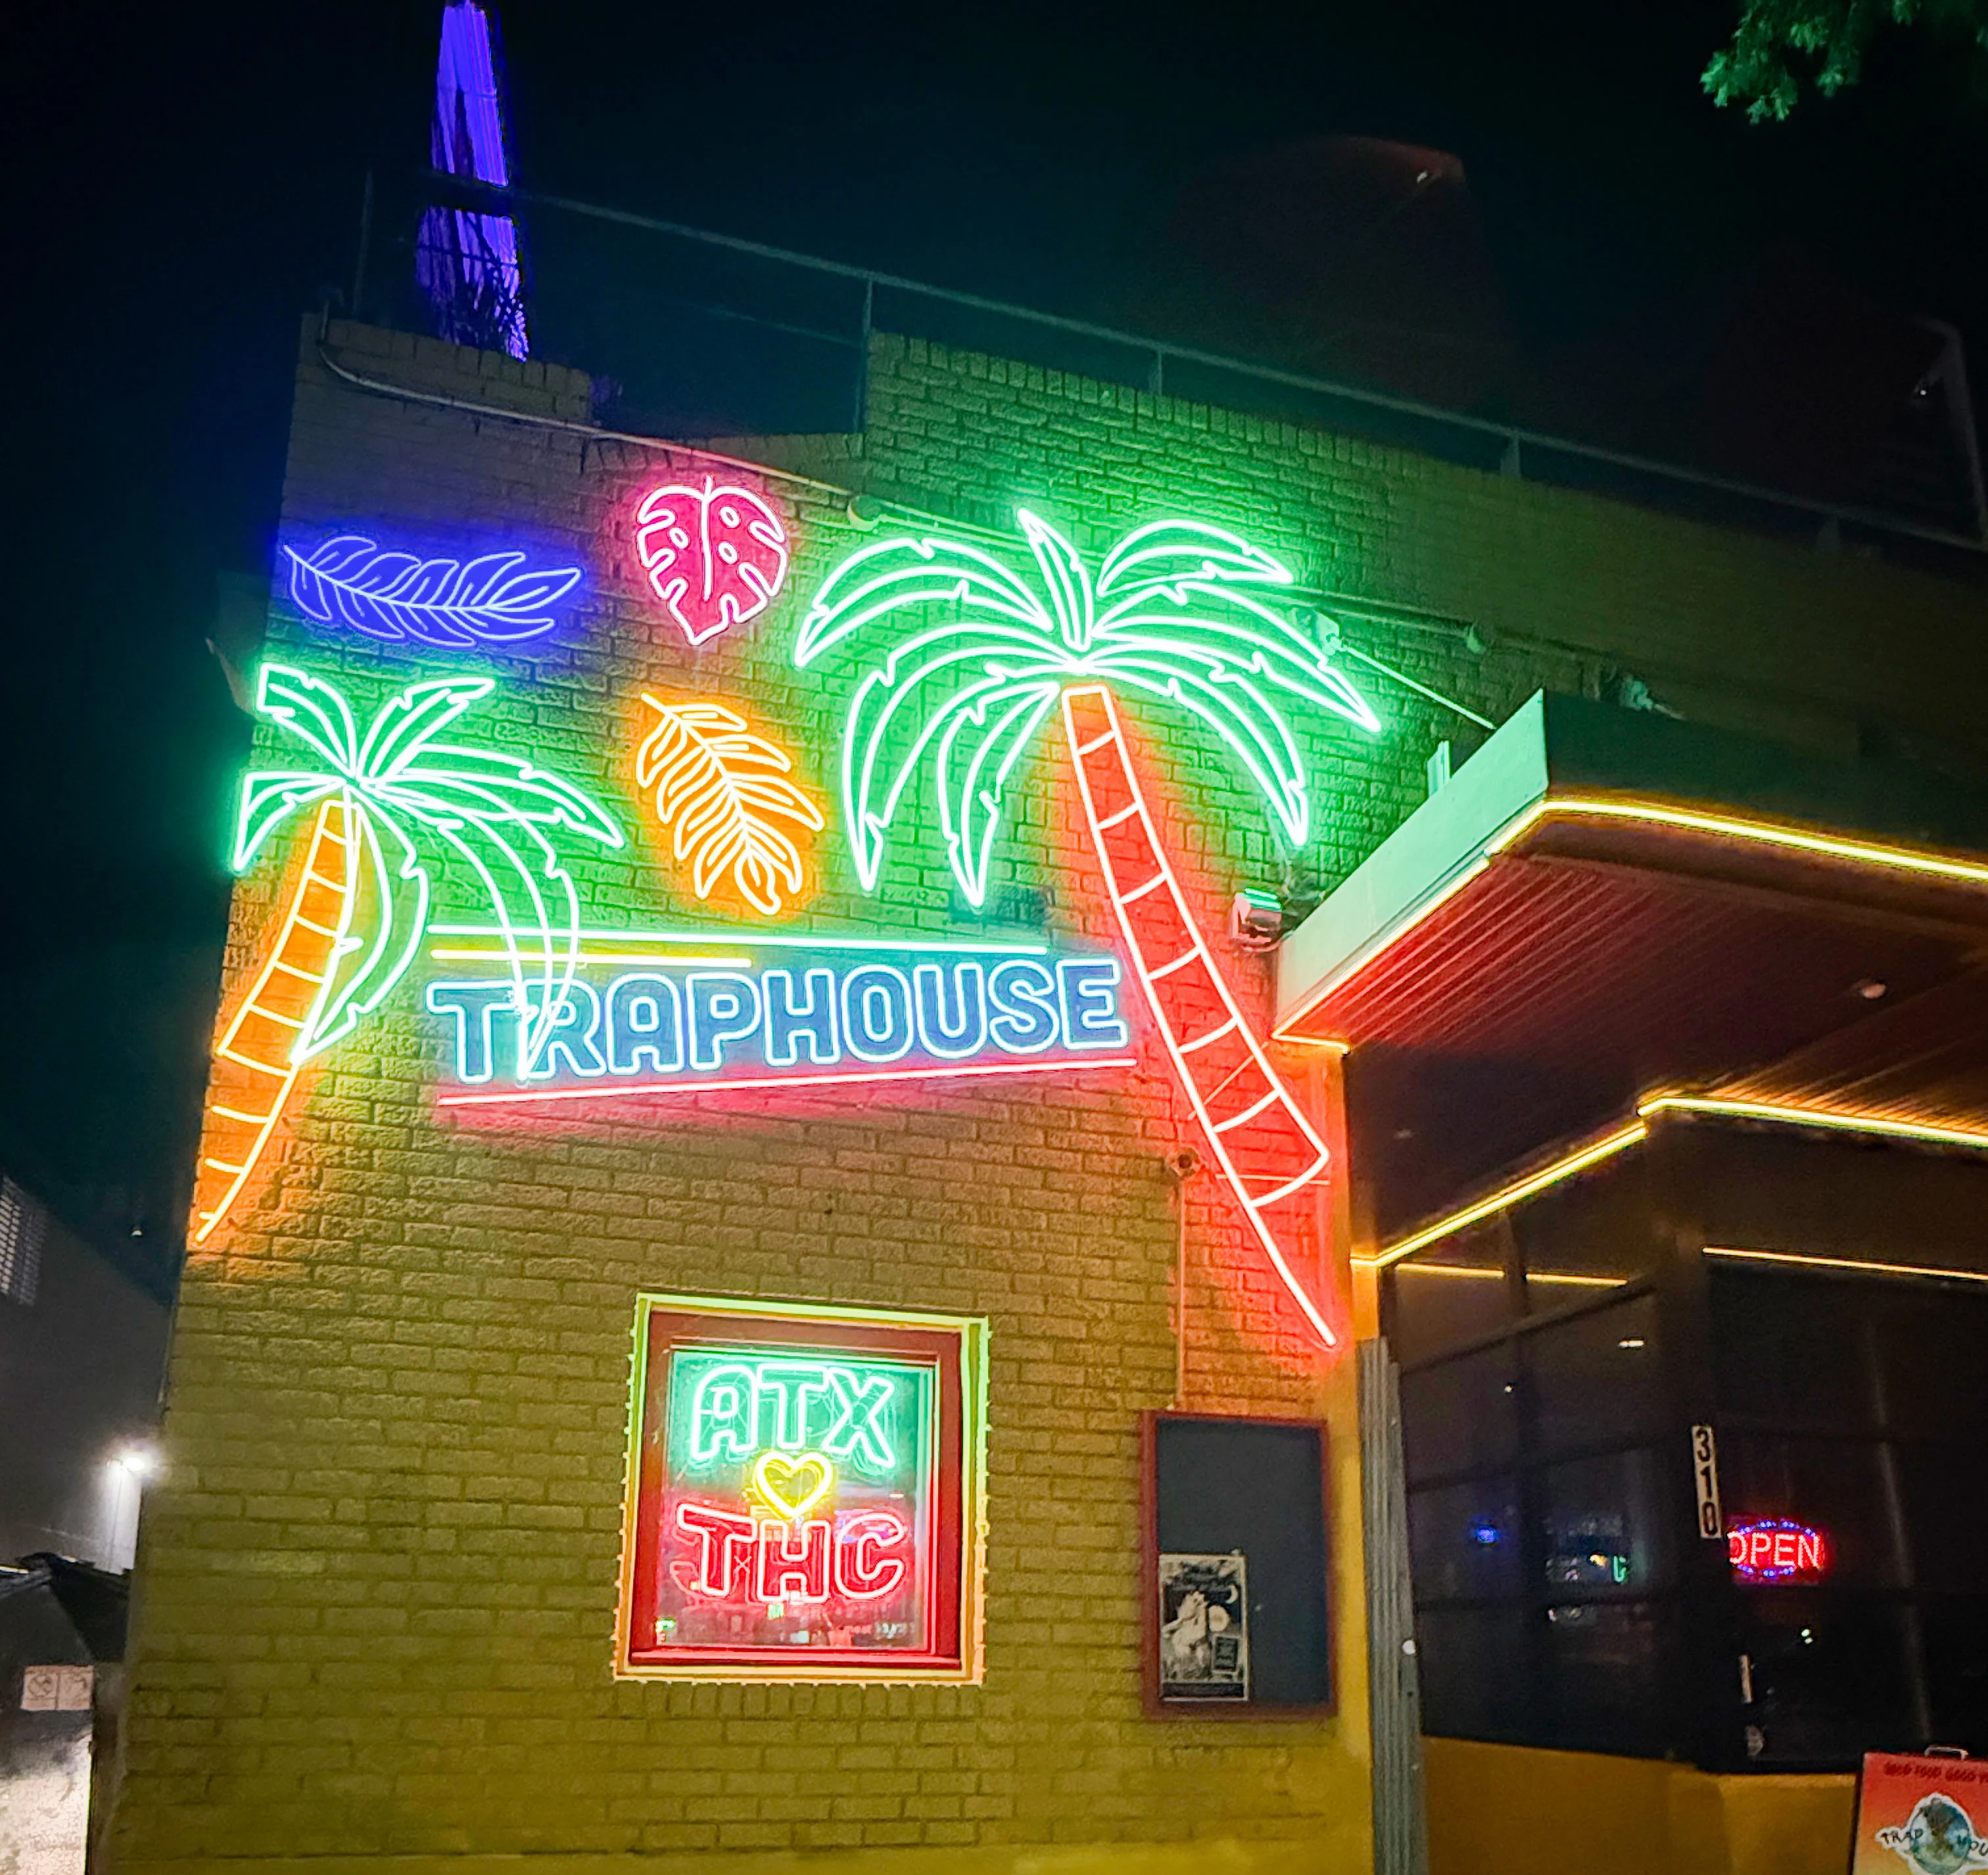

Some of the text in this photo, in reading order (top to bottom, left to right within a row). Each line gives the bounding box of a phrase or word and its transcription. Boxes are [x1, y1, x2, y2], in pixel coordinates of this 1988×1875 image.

[426, 957, 1129, 1084] TRAPHOUSE
[690, 1362, 896, 1469] ATX
[1695, 1428, 1717, 1536] 310
[676, 1502, 905, 1603] THC
[1726, 1531, 1821, 1568] OPEN
